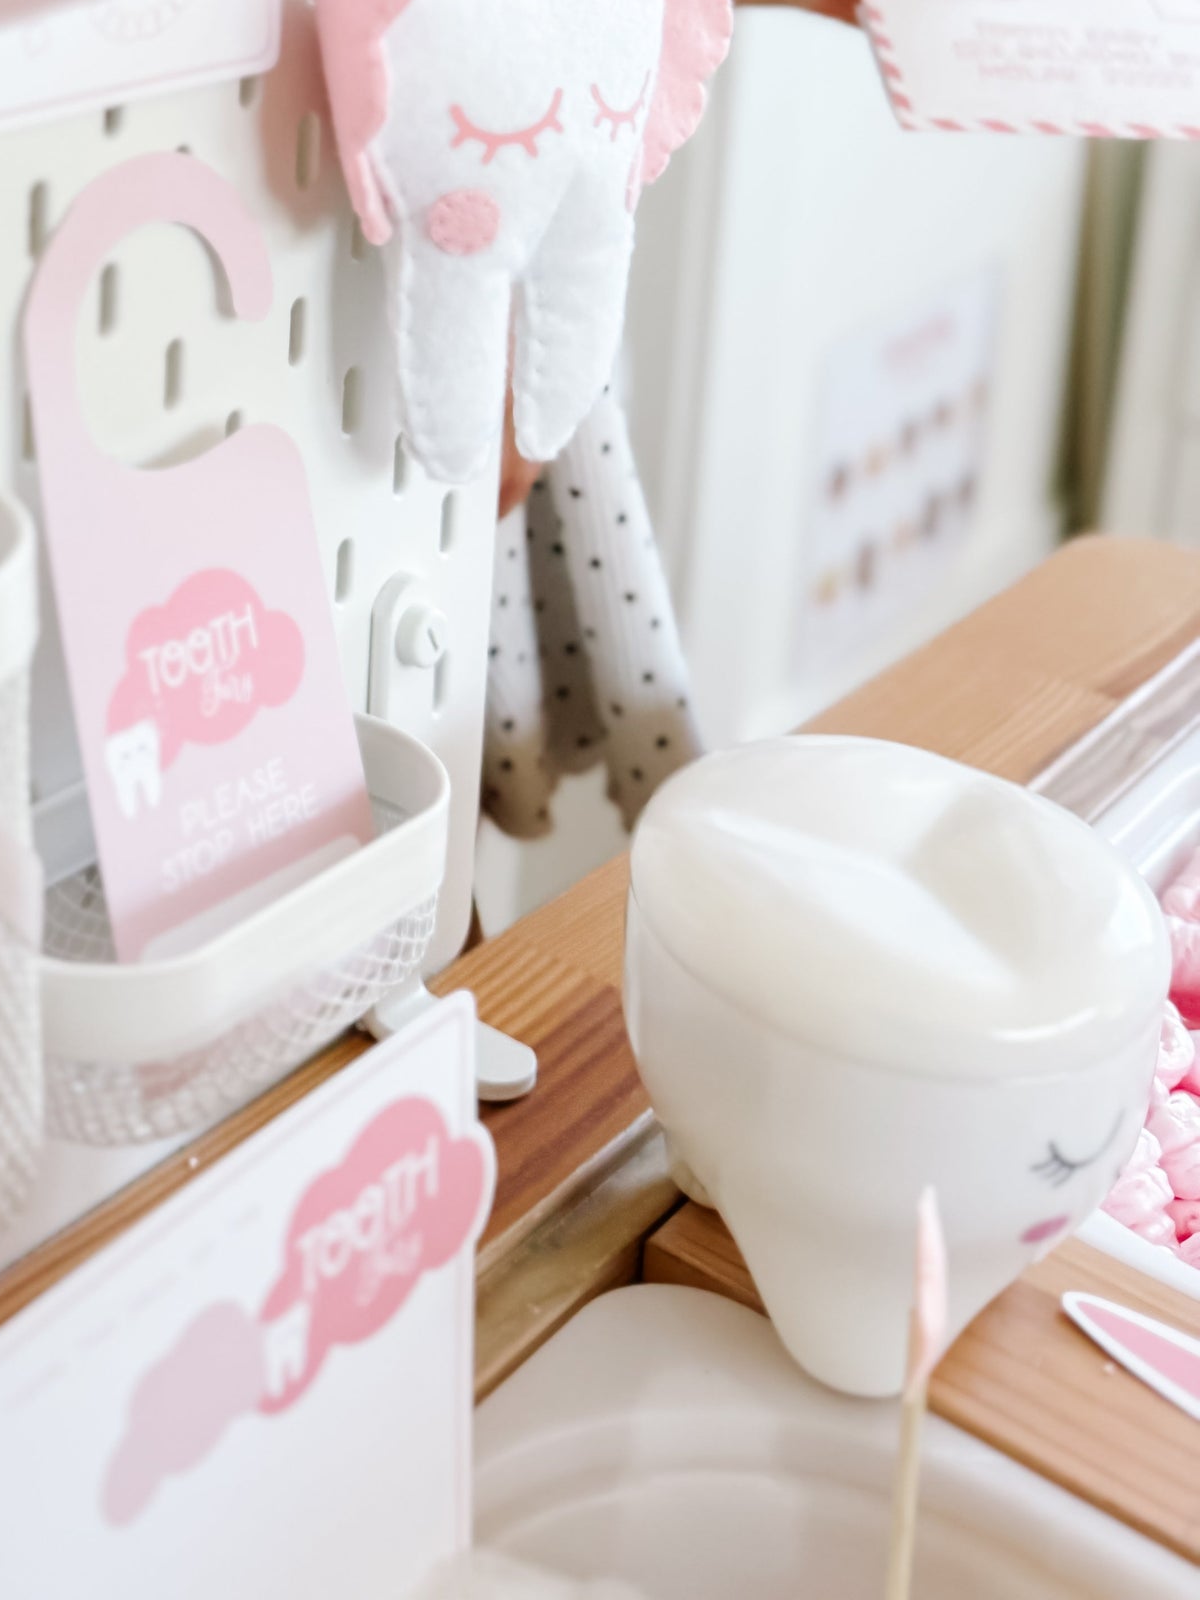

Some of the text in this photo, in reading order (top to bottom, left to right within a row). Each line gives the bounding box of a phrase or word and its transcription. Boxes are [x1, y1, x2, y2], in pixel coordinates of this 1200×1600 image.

[137, 602, 260, 697] TOOTH
[161, 782, 322, 893] STOP HERE
[179, 756, 288, 838] PLEASE
[296, 1134, 439, 1298] TOOTH
